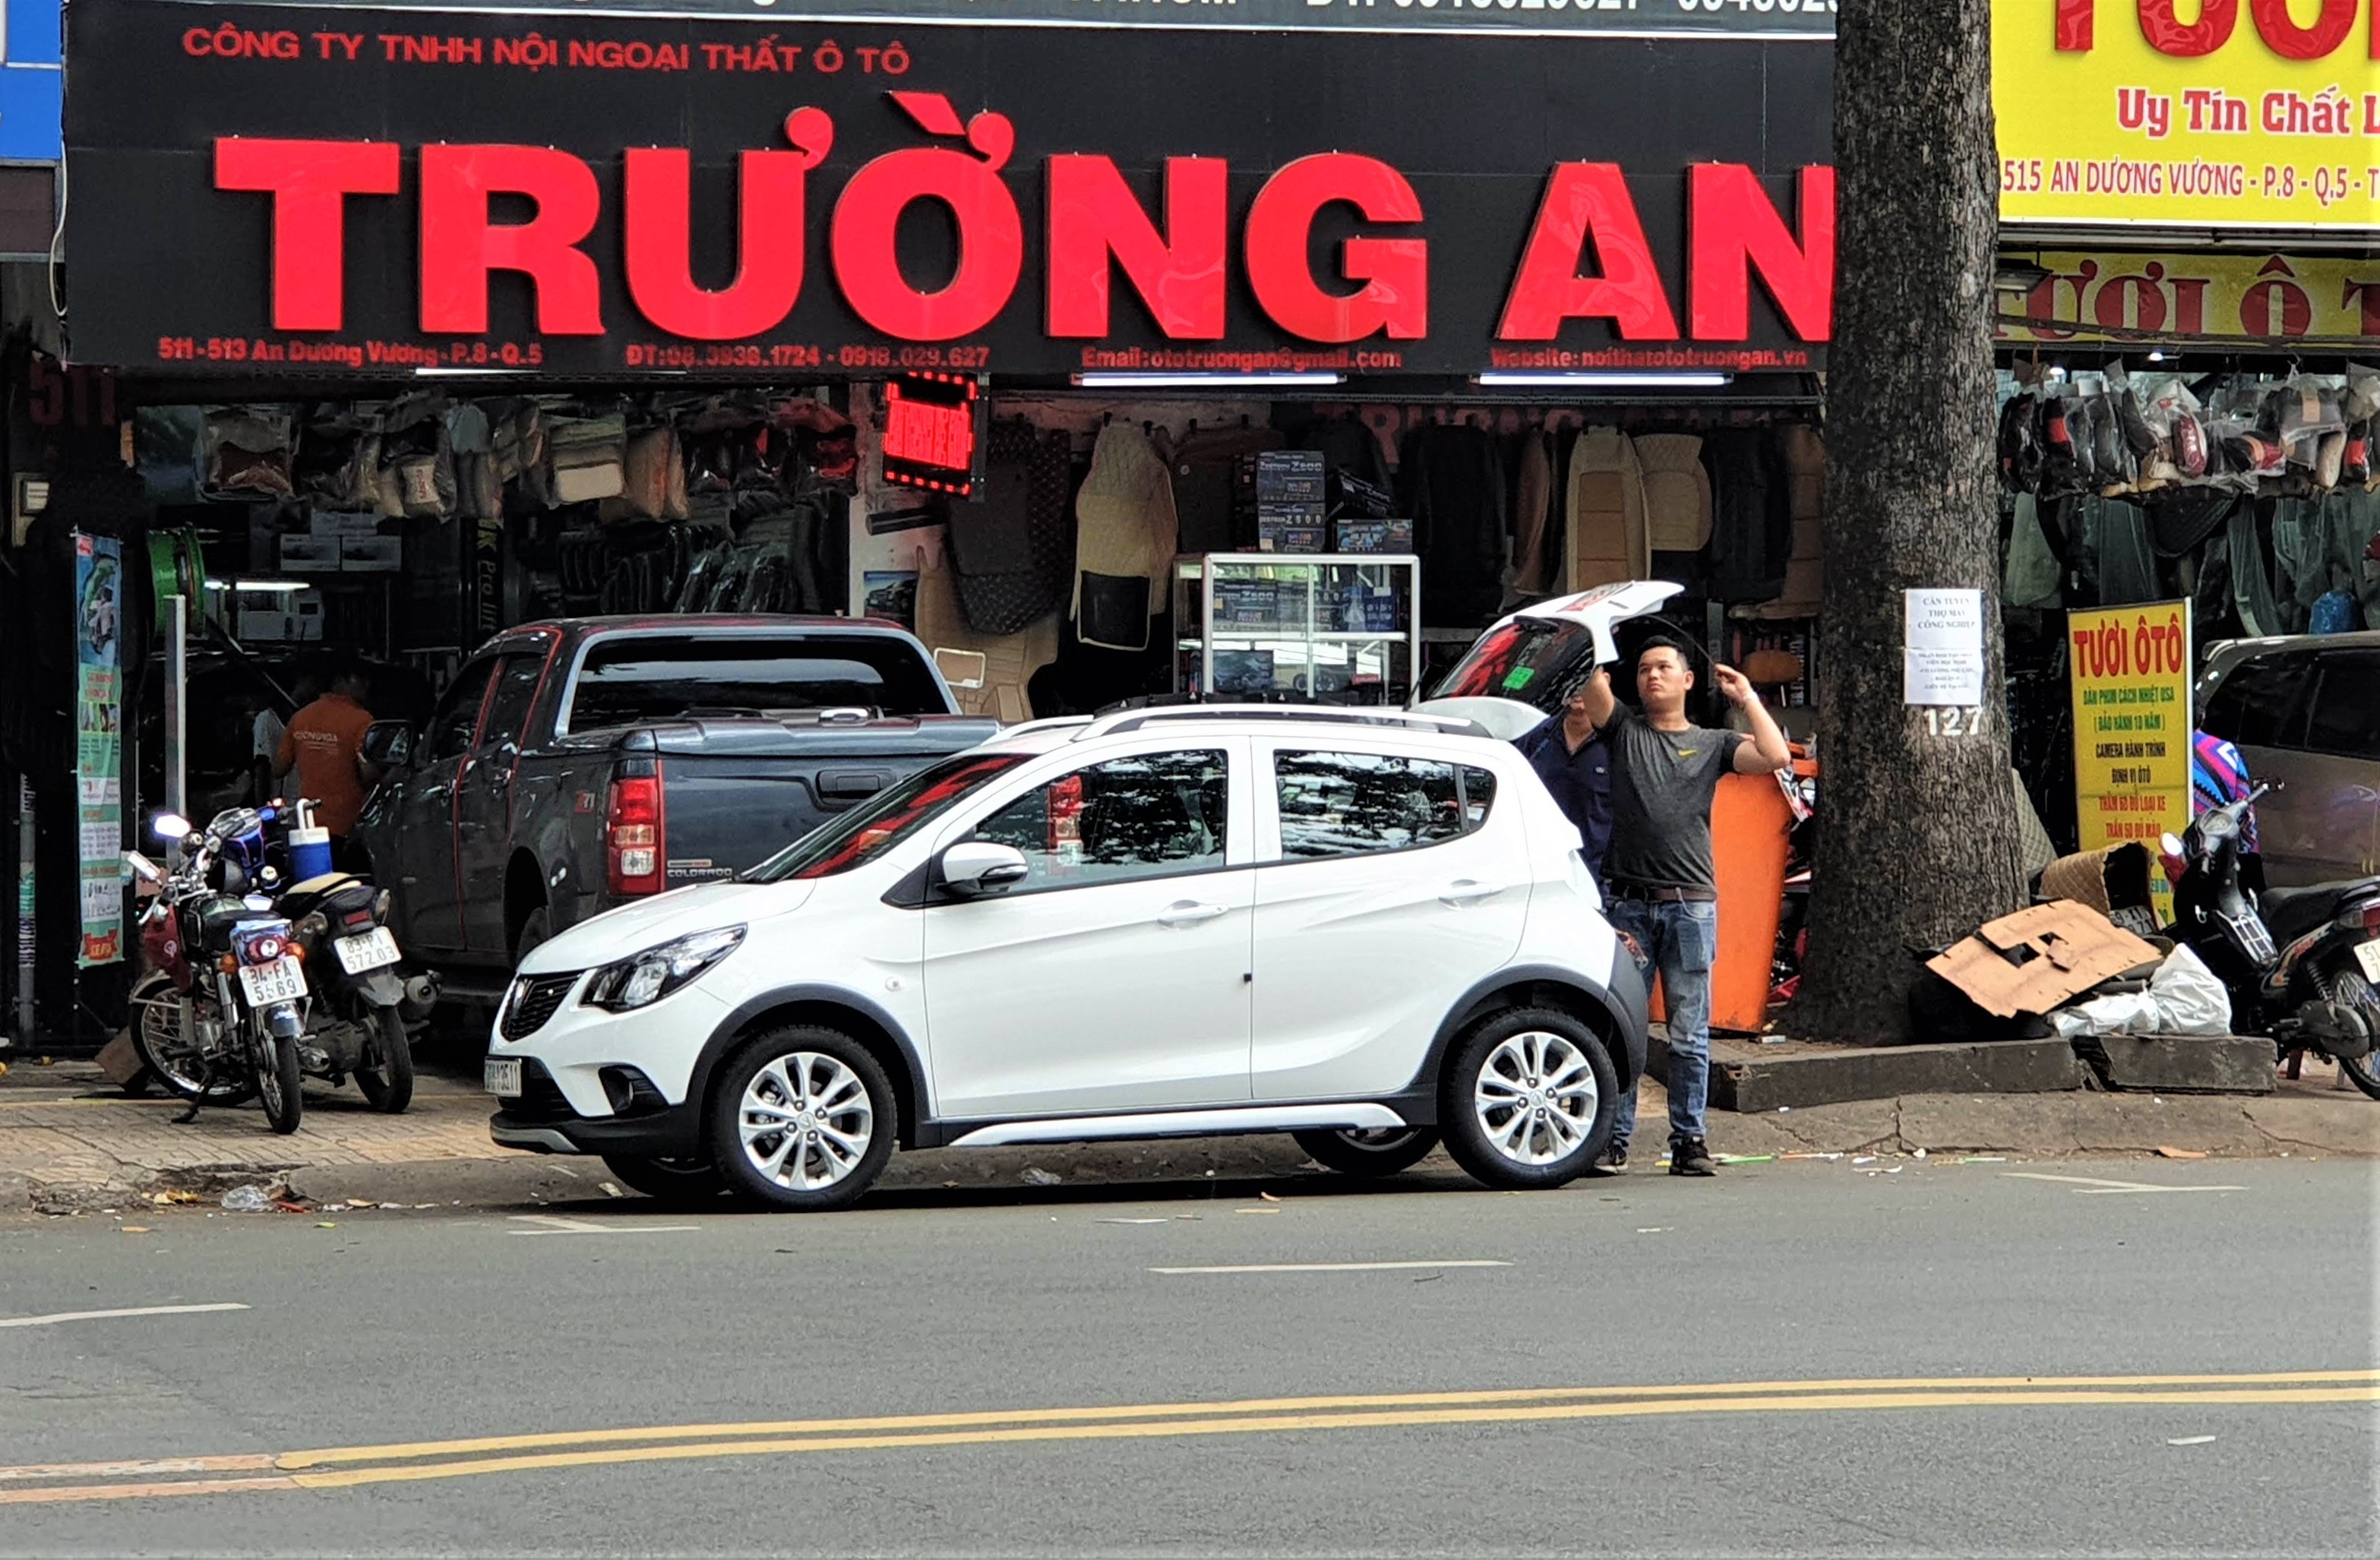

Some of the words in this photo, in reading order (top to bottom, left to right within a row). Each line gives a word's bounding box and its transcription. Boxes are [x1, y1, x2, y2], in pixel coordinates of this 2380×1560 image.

[182, 22, 301, 59] CÔNG
[311, 32, 364, 60] TY
[378, 34, 482, 65] TNHH
[494, 32, 558, 72] NỘI
[568, 40, 689, 72] NGOẠI
[701, 34, 801, 72] THẤT
[814, 39, 844, 72] Ô
[856, 40, 909, 74] TÔ
[2118, 88, 2170, 137] Uy
[2183, 90, 2247, 131] Tín
[2262, 86, 2350, 134] Chất
[2002, 159, 2041, 192] 515
[2050, 161, 2080, 193] AN
[2086, 156, 2162, 195] DƯƠNG
[2168, 158, 2243, 197] VƯƠNG
[2263, 166, 2294, 197] P.8
[2314, 166, 2348, 207] Q.5
[214, 90, 1428, 343] TRƯỜNG
[1493, 161, 1836, 342] AN
[251, 341, 285, 362] An
[2074, 617, 2129, 678] TƯƠI
[1923, 706, 1983, 736] 127
[2096, 742, 2123, 759] CAMERA
[667, 867, 733, 878] COLORADO
